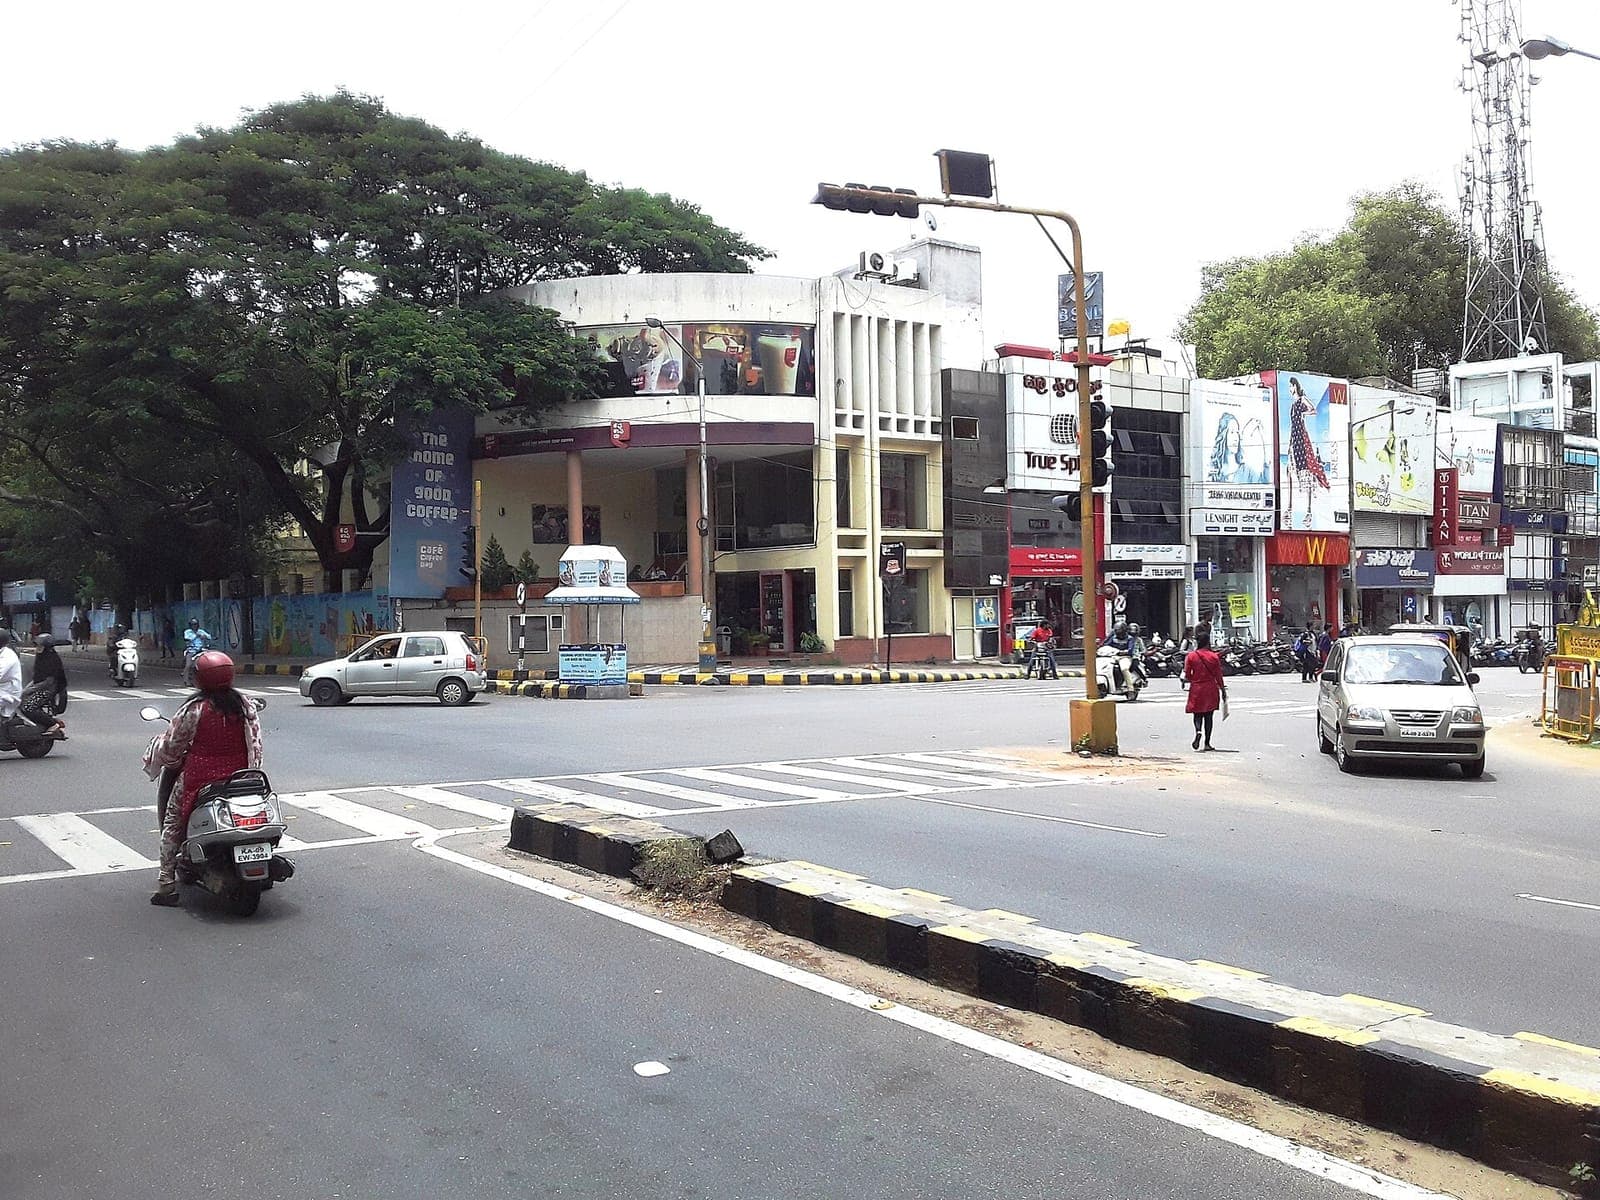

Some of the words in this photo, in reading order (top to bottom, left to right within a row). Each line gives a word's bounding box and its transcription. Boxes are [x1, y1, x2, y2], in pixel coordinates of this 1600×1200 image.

[1024, 451, 1058, 470] True
[1439, 486, 1450, 540] TITAN
[1459, 503, 1490, 517] ITAN
[1306, 536, 1327, 565] W
